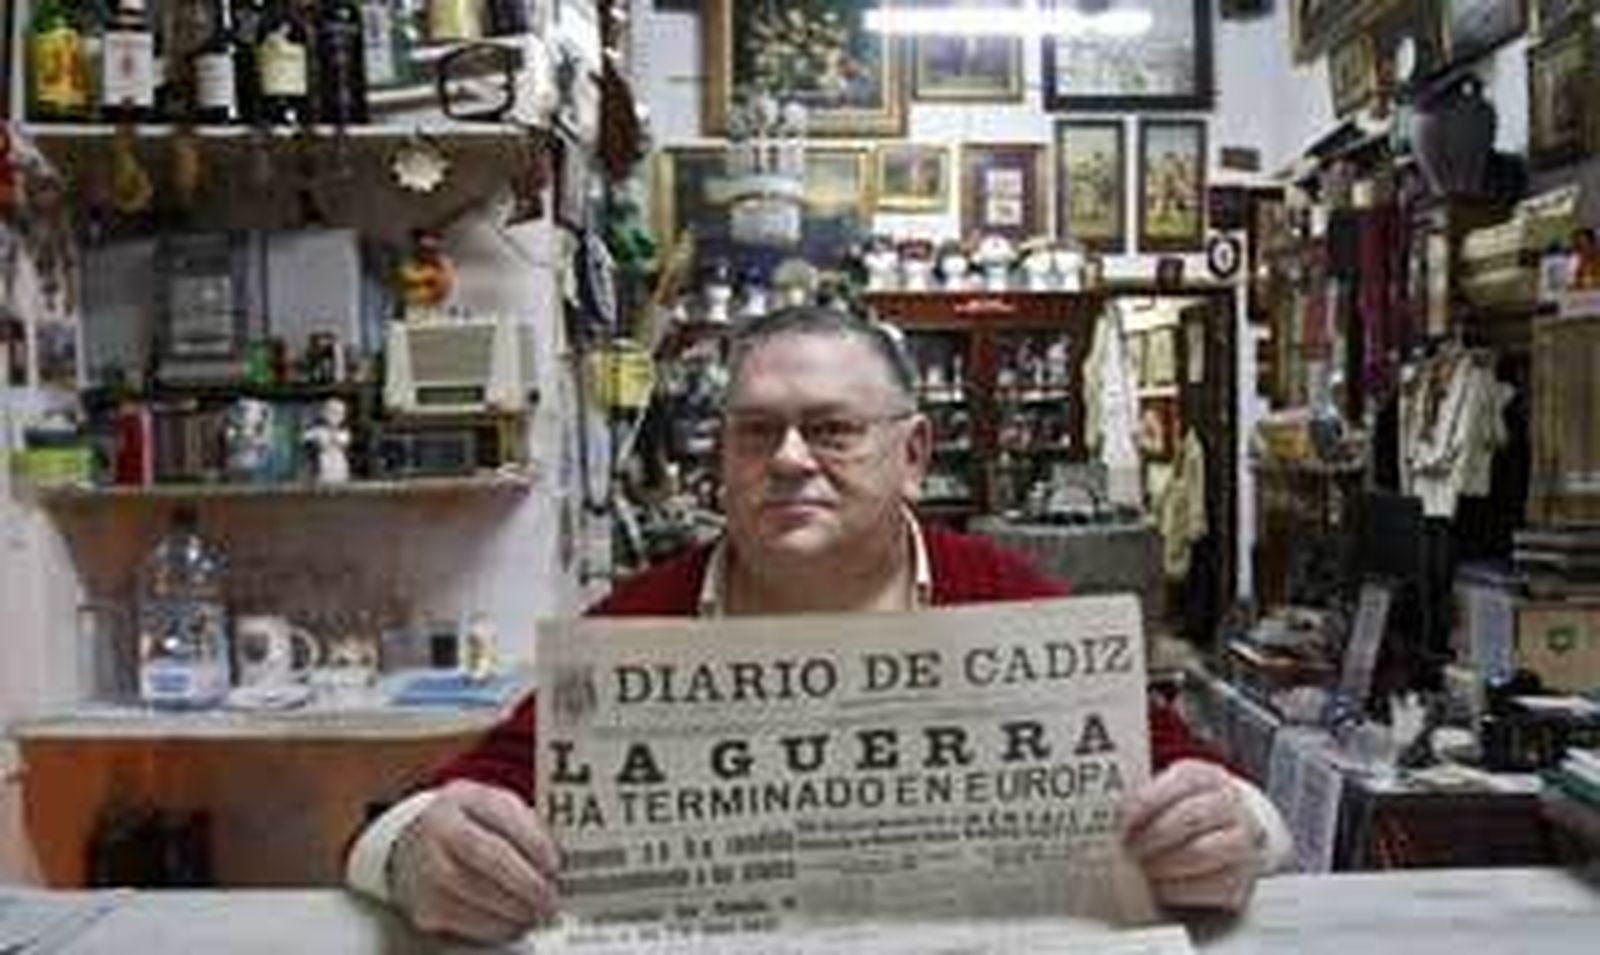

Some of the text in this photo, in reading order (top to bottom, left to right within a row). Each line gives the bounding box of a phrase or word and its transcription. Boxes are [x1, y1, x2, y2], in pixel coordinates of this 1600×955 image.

[616, 658, 838, 704] DIARIO
[864, 652, 941, 692] DE
[964, 636, 1132, 686] CADIZ
[550, 715, 1115, 784] LA GUERRA
[549, 795, 605, 828] HA
[618, 778, 884, 824] TERMINADO
[897, 775, 952, 804] EN
[965, 764, 1123, 803] EUROPA
